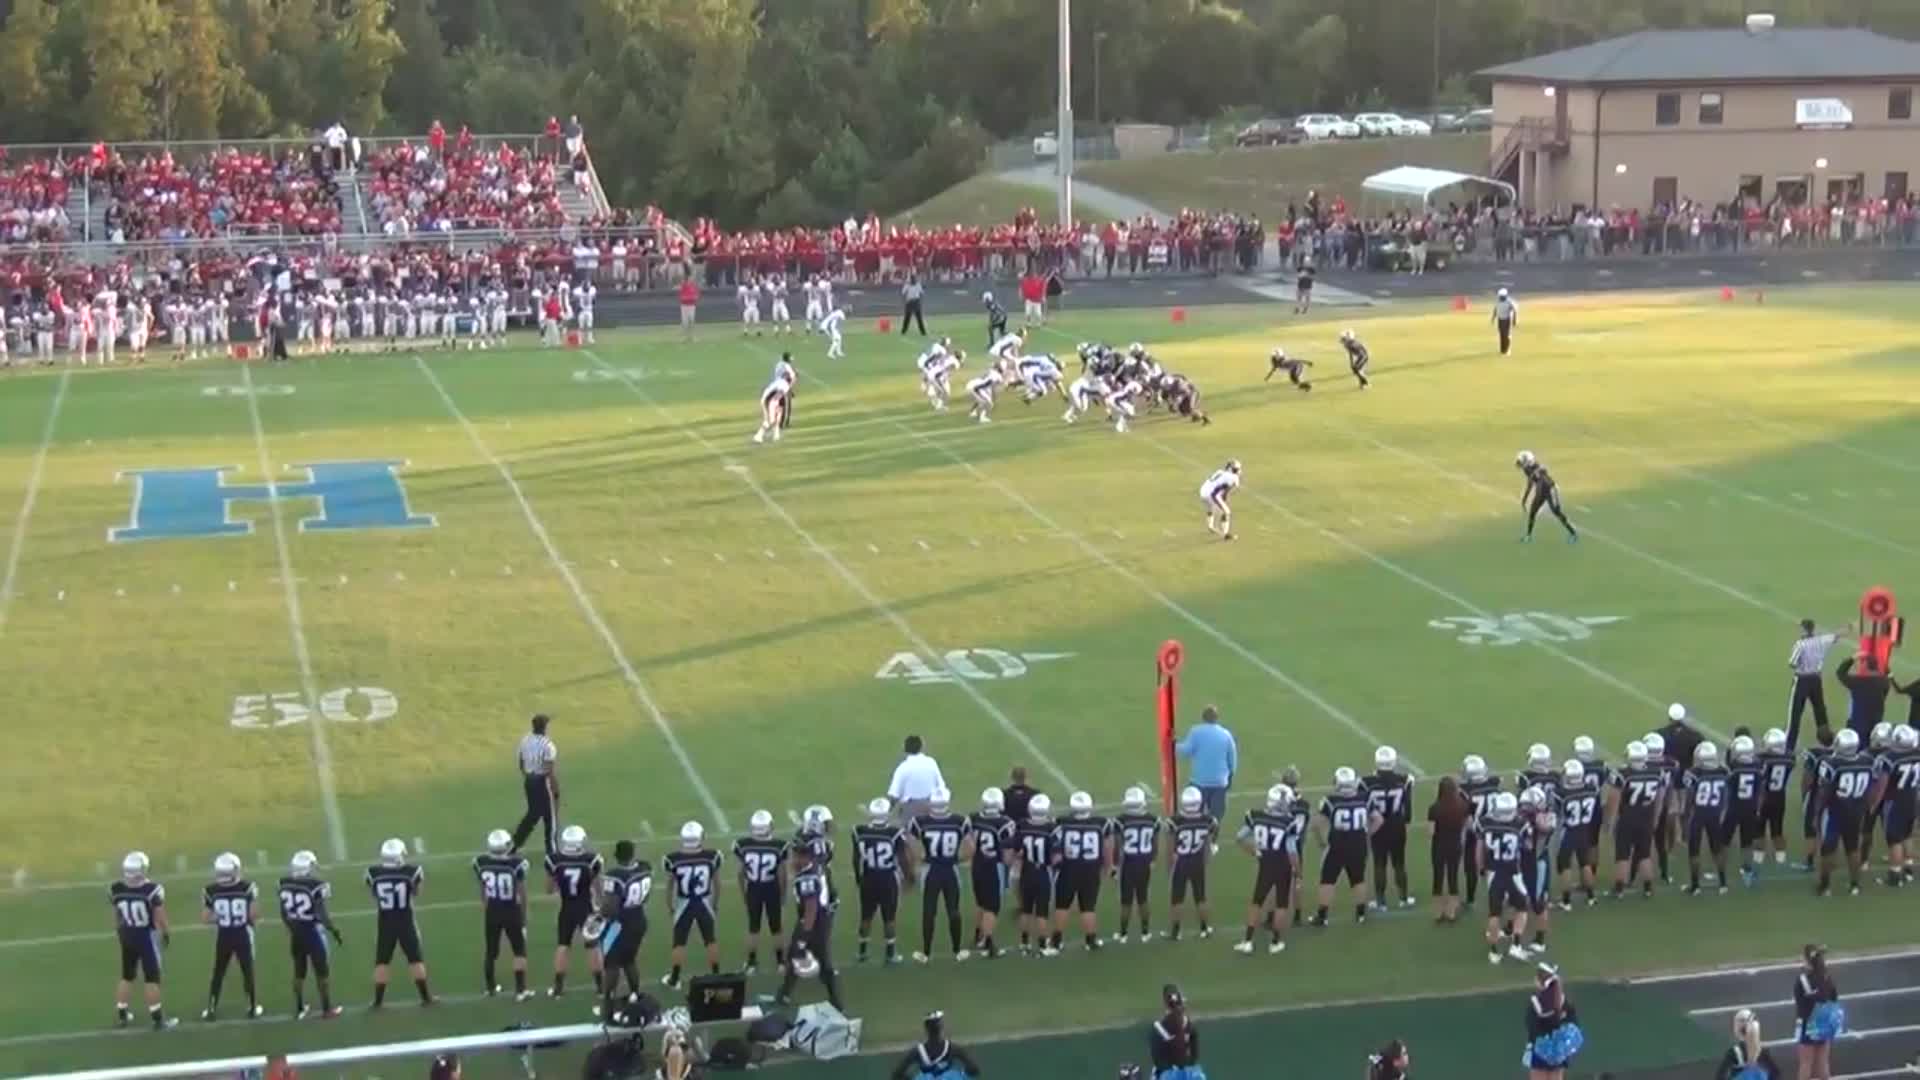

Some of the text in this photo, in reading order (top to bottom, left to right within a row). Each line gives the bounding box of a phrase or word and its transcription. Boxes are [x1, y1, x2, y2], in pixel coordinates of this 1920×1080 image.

[874, 648, 1027, 684] 40
[231, 686, 398, 728] 50
[1737, 773, 1754, 799] 5
[1769, 764, 1786, 791] 9
[1836, 771, 1870, 798] 90
[1629, 780, 1658, 806] 75
[1566, 797, 1595, 826] 33
[858, 841, 894, 870] 42
[1023, 835, 1045, 864] 11
[1064, 830, 1099, 859] 69
[1123, 828, 1153, 854] 20
[1176, 829, 1208, 854] 35
[1485, 832, 1518, 860] 43
[676, 864, 709, 896] 73
[744, 852, 777, 882] 32
[376, 882, 407, 910] 51
[481, 870, 514, 900] 30
[563, 868, 581, 896] 7
[117, 900, 149, 928] 10
[213, 898, 248, 927] 99
[279, 890, 313, 921] 22
